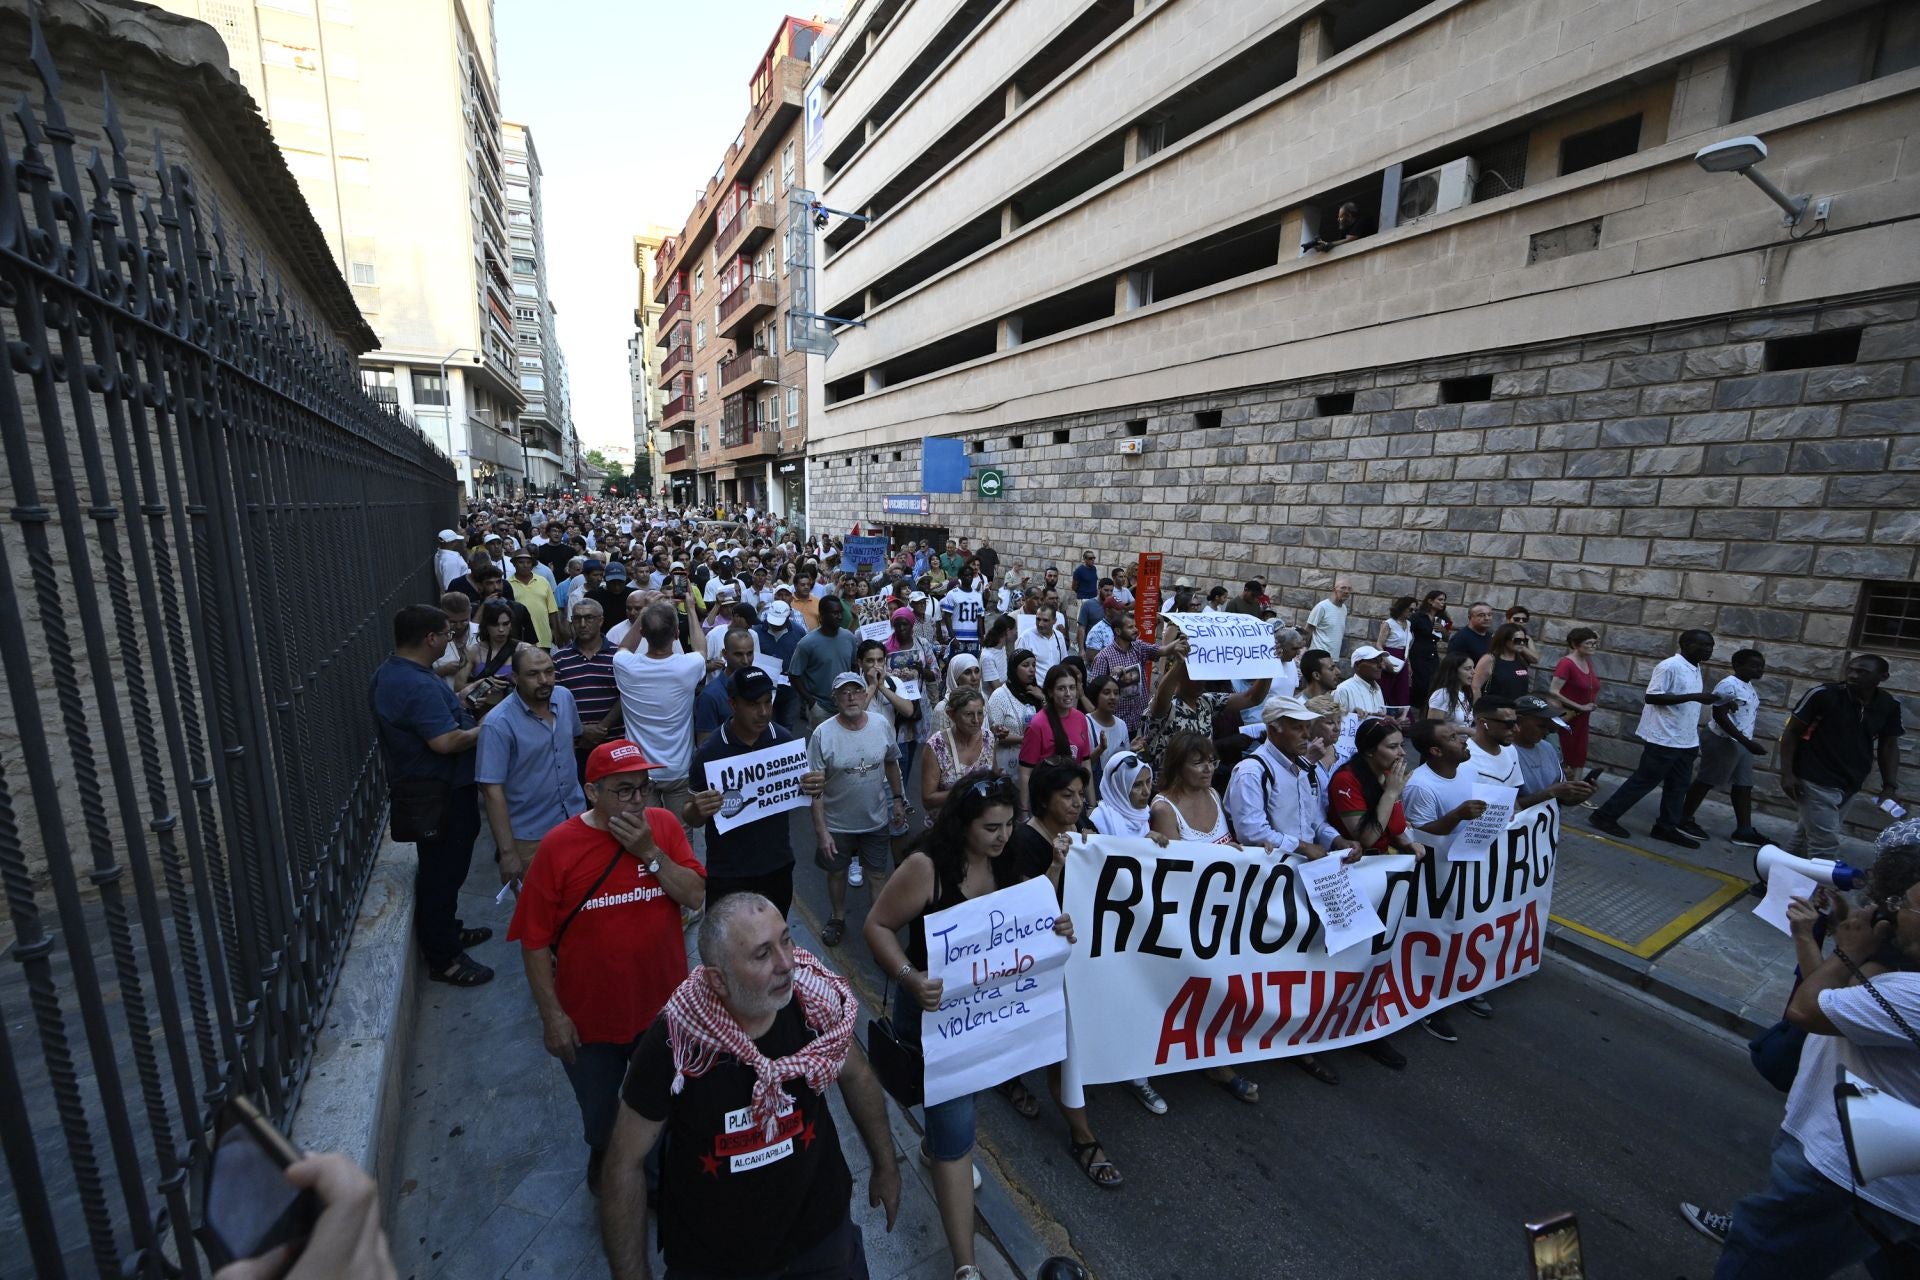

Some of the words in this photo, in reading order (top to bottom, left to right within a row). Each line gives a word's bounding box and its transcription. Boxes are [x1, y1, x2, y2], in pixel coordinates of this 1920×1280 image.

[808, 86, 822, 143] P
[959, 602, 978, 623] 66
[1185, 621, 1275, 639] SENTIMIENTO
[766, 751, 807, 771] SOBRAN
[744, 764, 766, 784] NO
[757, 776, 801, 797] SOBRA
[758, 789, 805, 809] RACISTA
[1405, 804, 1557, 921] MURCI
[1314, 874, 1337, 885] ESPERO
[933, 923, 981, 966] Torre
[986, 909, 1055, 951] Pacheco
[972, 948, 1034, 986] Unido
[938, 1001, 1030, 1039] violencia
[734, 1143, 791, 1167] ALCANTARILLA
